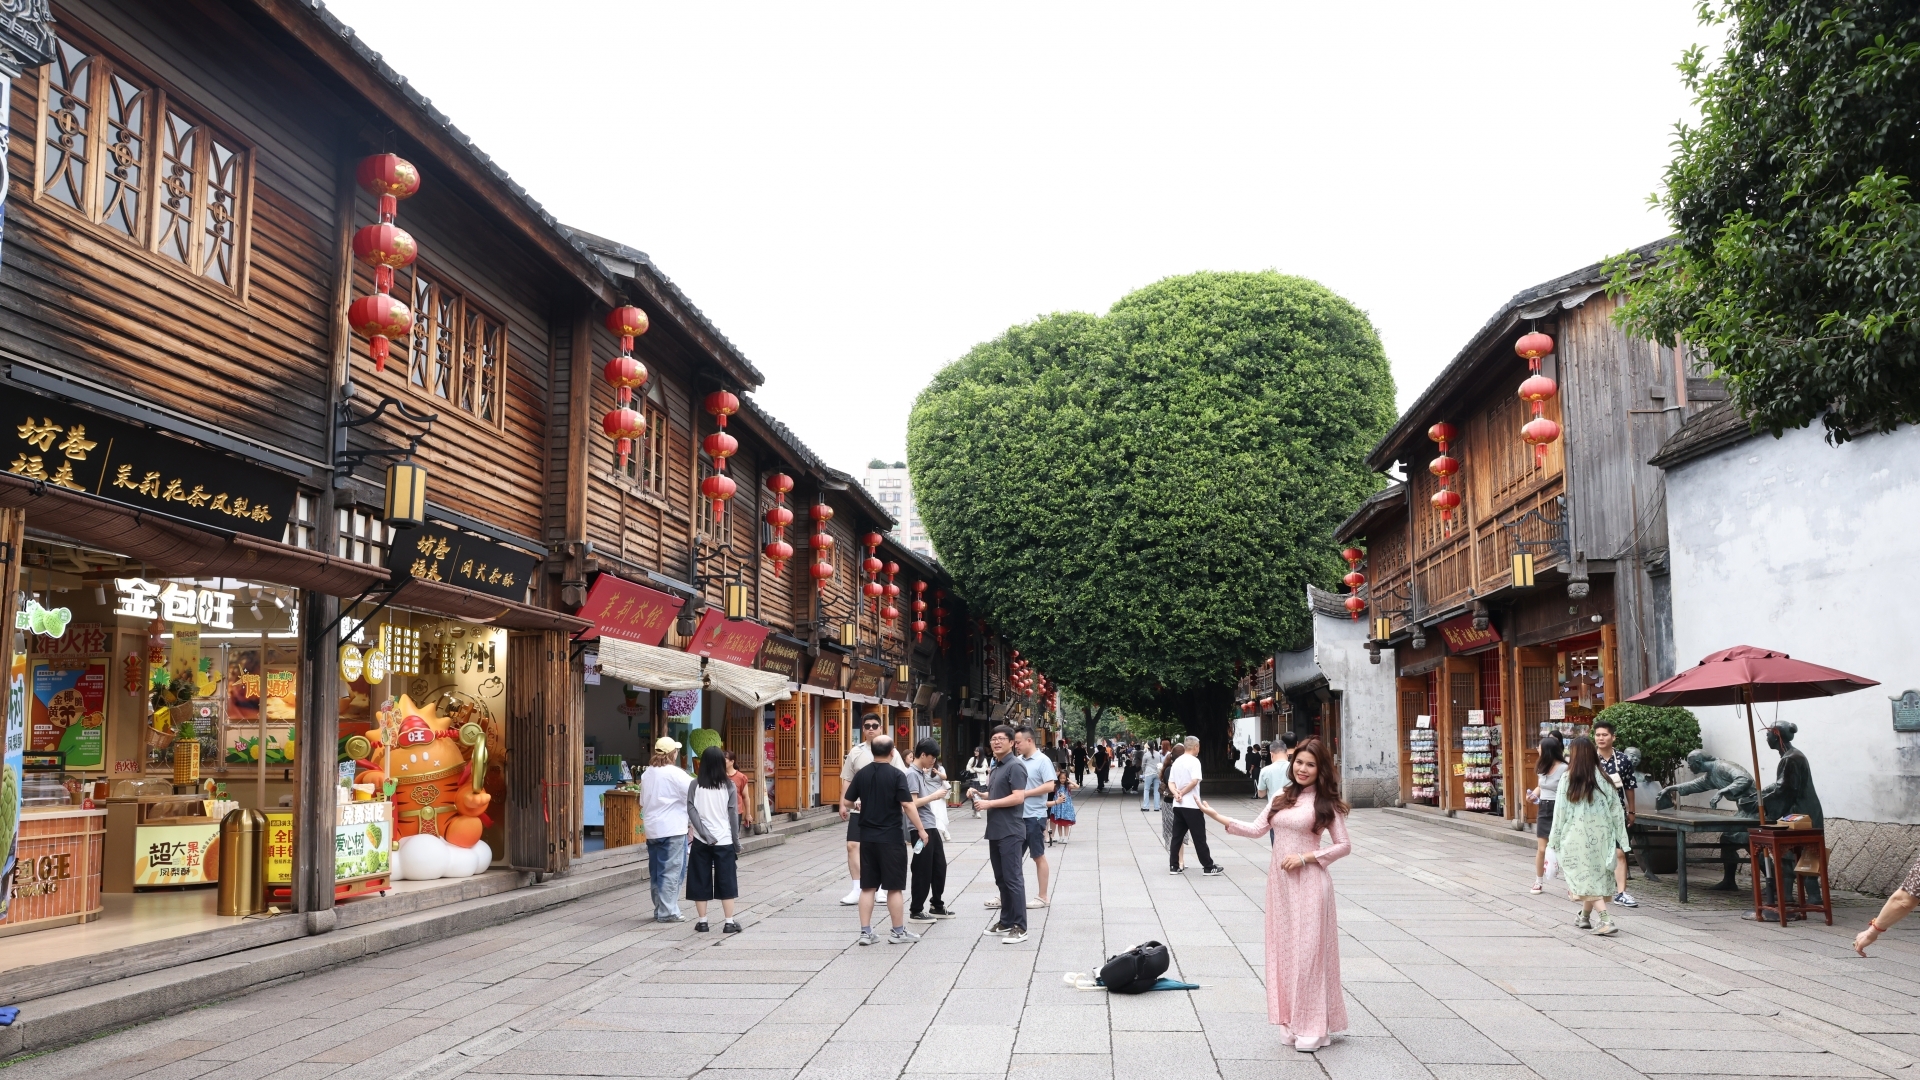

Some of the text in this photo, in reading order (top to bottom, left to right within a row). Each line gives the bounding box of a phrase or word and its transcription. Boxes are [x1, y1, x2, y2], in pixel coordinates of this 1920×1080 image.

[17, 416, 98, 461] 坊巷
[9, 453, 86, 492] 福来
[112, 464, 272, 523] 茉莉花茶凤梨酥
[417, 535, 451, 560] 坊巷
[113, 577, 235, 630] 金包旺
[38, 628, 105, 654] 消火栓
[408, 731, 425, 742] 旺
[342, 804, 385, 826] 免费试吃
[336, 831, 365, 852] 爱心树
[160, 867, 190, 877] 凤梨酥
